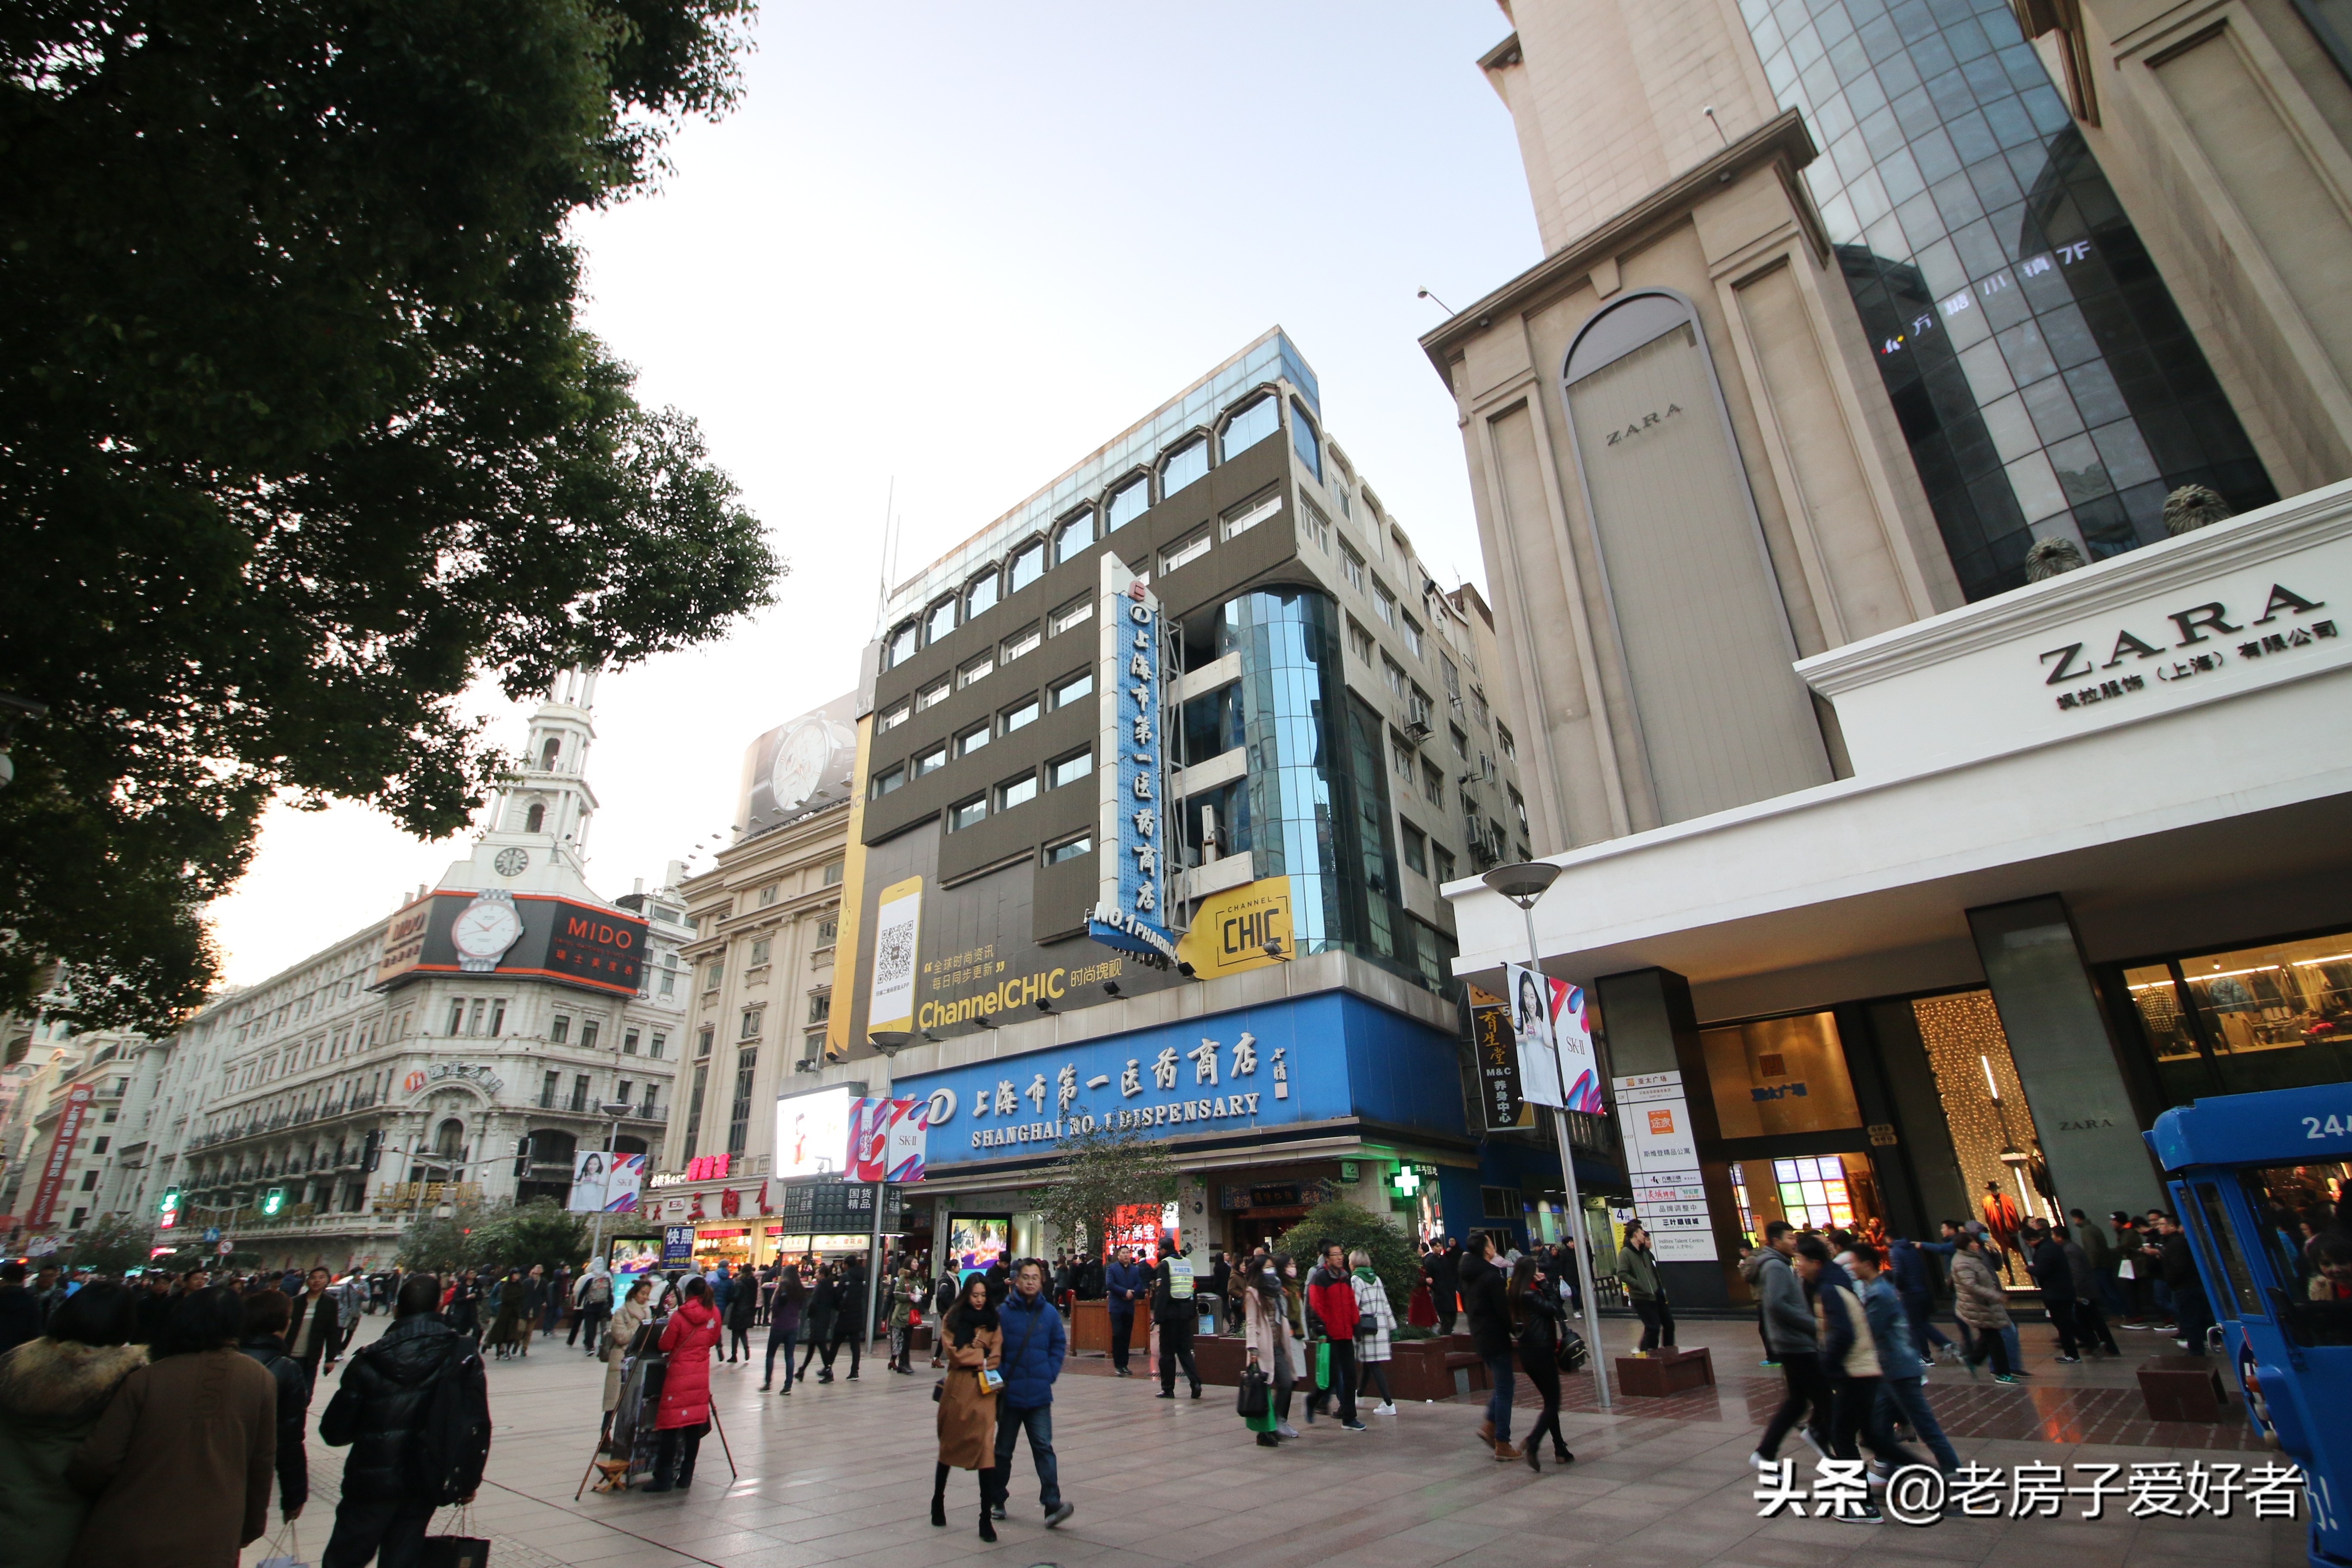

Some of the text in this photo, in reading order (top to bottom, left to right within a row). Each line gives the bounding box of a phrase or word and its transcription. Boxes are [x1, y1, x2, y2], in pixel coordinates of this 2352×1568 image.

[2056, 240, 2091, 265] 7F
[1607, 404, 1683, 446] ZARA
[2040, 583, 2325, 685] ZARA
[1130, 629, 1157, 910] 上海市第一医药商店
[1228, 896, 1272, 913] CHANNEL
[1094, 901, 1136, 934] NO.1
[567, 916, 632, 949] MIDO
[1223, 908, 1281, 954] CHIC
[919, 968, 1065, 1029] ChannelCHIC
[1071, 958, 1122, 988] 时尚瑰视
[1478, 1011, 1506, 1065] 育生堂
[1566, 1036, 1585, 1055] SK-II
[972, 1032, 1258, 1118] 上海市第一医药商店
[1486, 1067, 1511, 1077] M&C
[1638, 1075, 1667, 1084] 亚太广场
[1494, 1080, 1511, 1123] 养身中心
[971, 1120, 1063, 1148] SHANGHAI
[1119, 1092, 1260, 1128] DISPENSARY
[2059, 1118, 2114, 1131] ZARA
[899, 1135, 917, 1146] SK-II
[1643, 1147, 1691, 1158] 斯维登精品公寓
[848, 1188, 872, 1199] 国货
[848, 1199, 871, 1210] 精品
[1659, 1204, 1697, 1213] 品牌调整中
[1663, 1218, 1700, 1226] 三叶眼镜城
[667, 1228, 694, 1245] 快照
